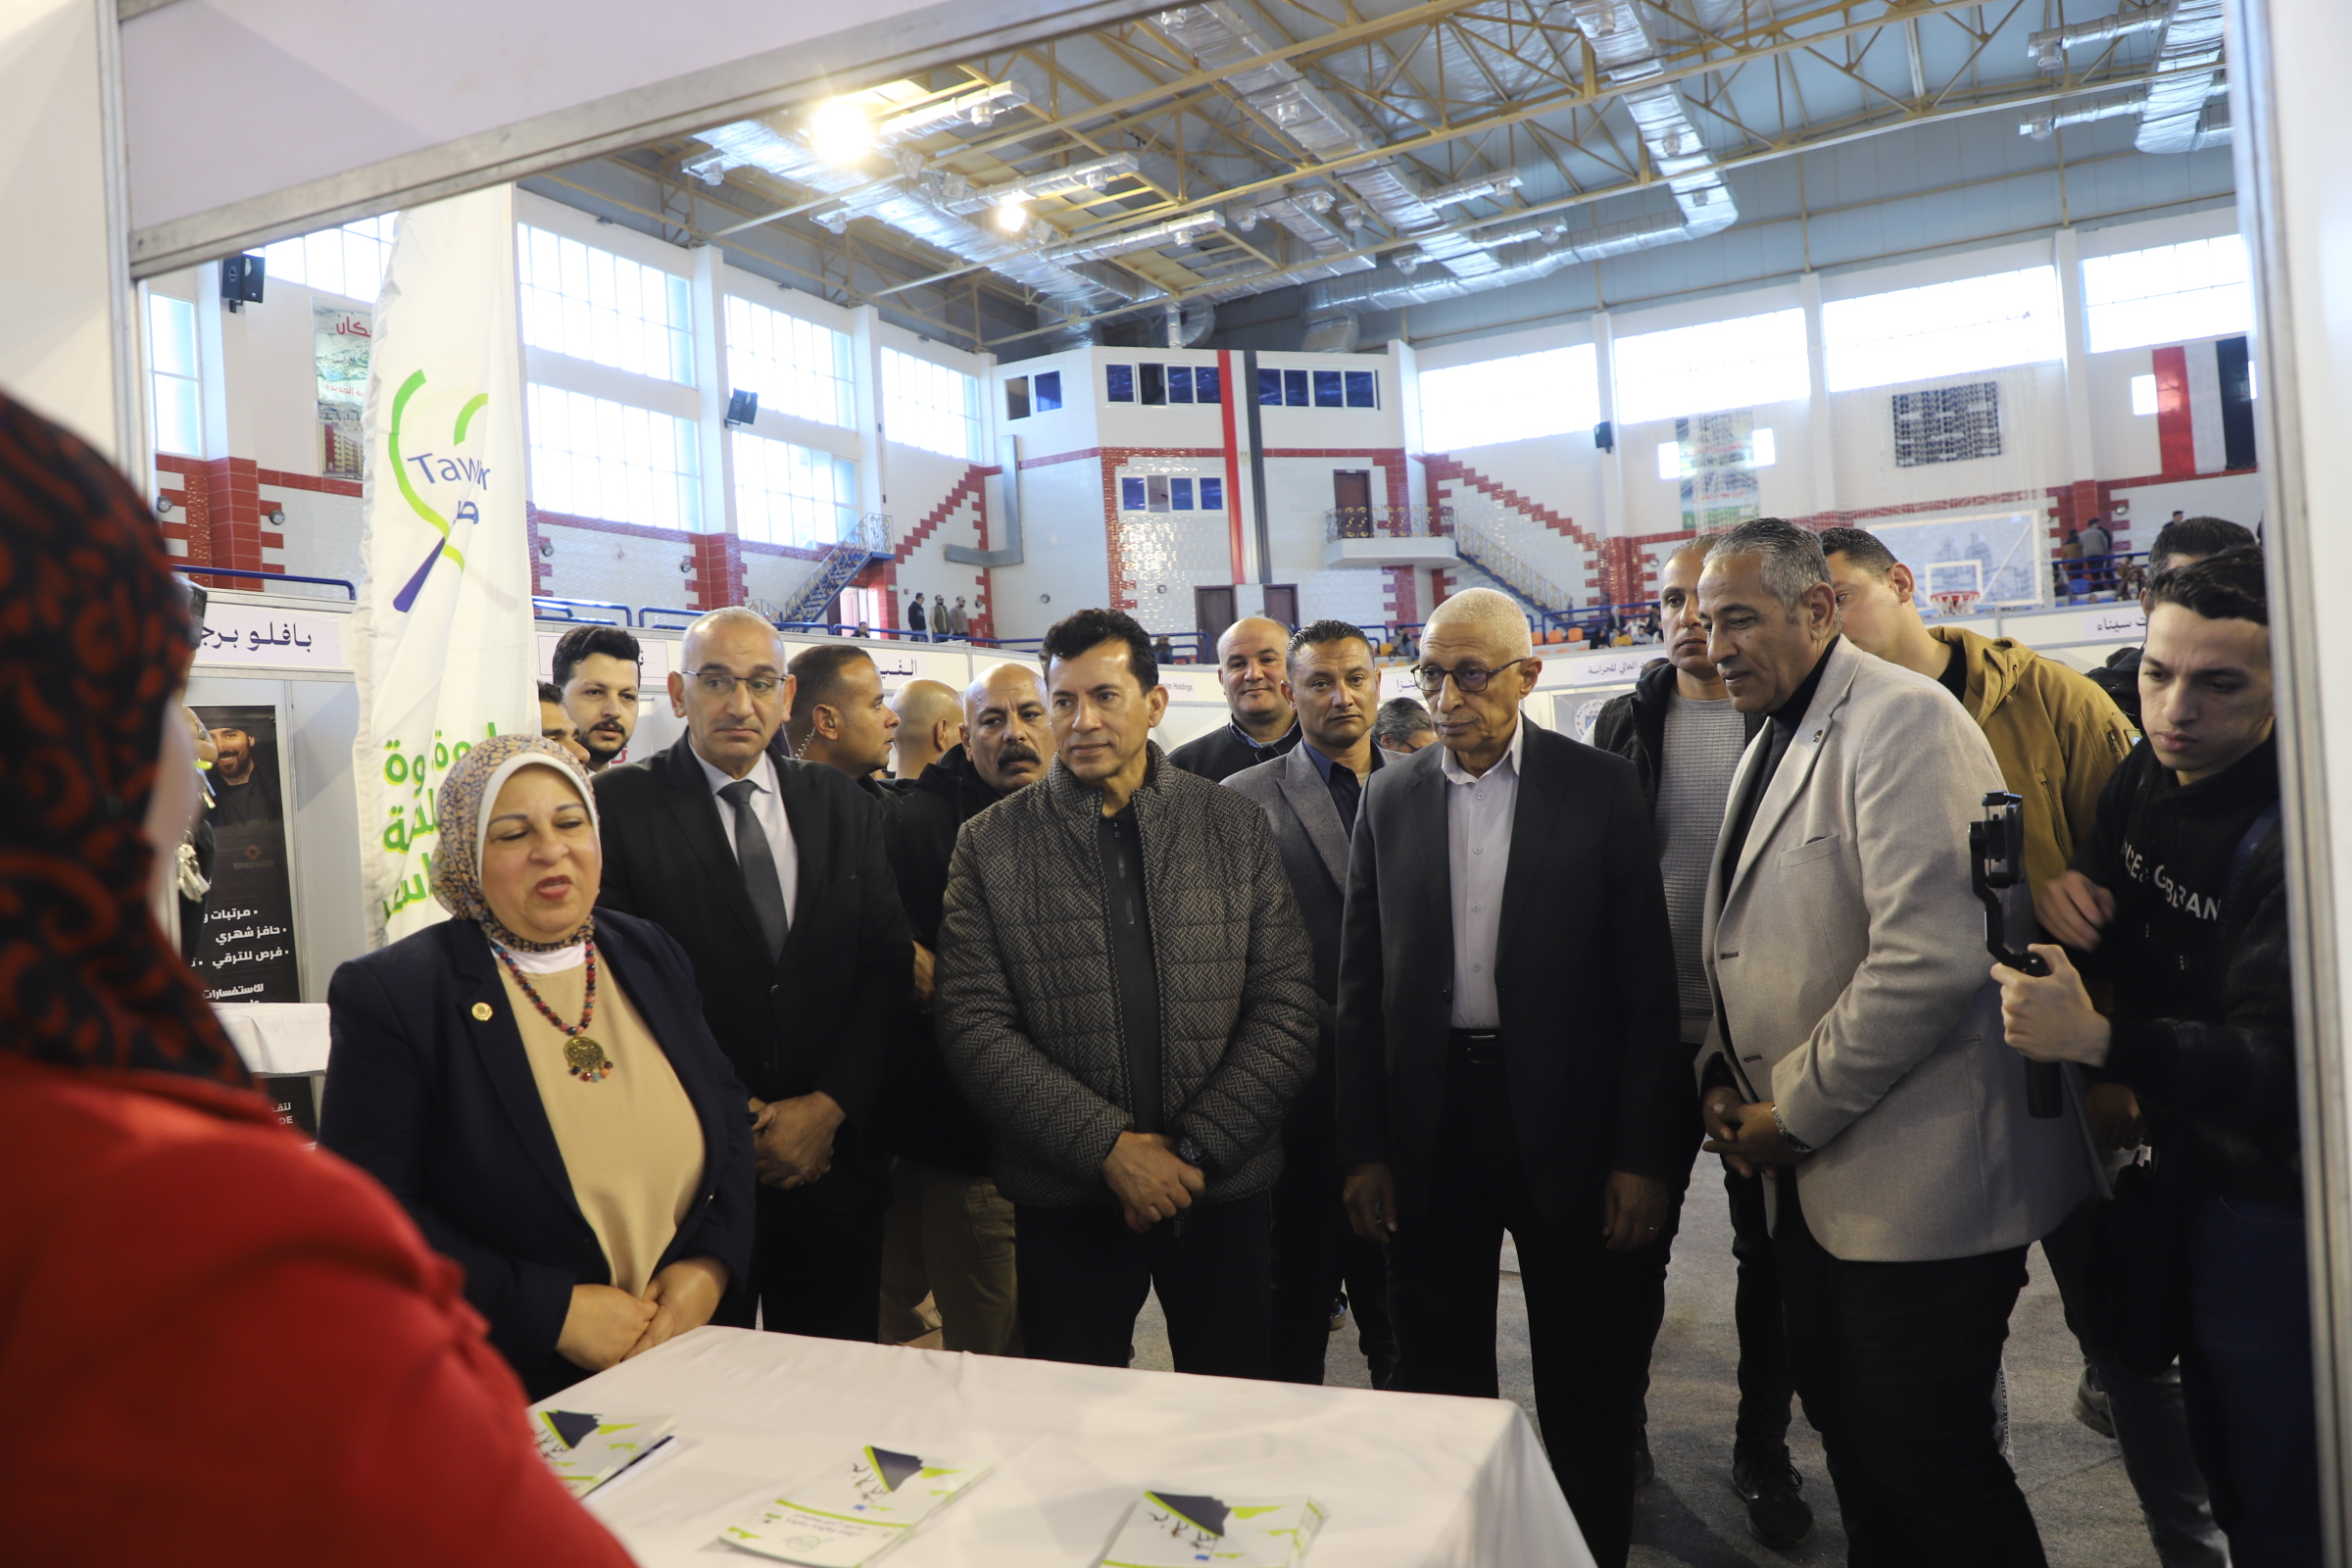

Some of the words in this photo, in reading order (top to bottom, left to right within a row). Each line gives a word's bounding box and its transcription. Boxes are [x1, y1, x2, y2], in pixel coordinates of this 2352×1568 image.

[335, 314, 372, 338] كان
[2097, 616, 2132, 632] سيناء
[200, 625, 239, 650] برج
[246, 620, 313, 653] بافلو
[879, 658, 917, 679] الفي
[1588, 663, 1617, 676] للحراسة
[1618, 661, 1638, 675] العالي
[211, 907, 251, 921] مرتبات
[215, 926, 254, 946] شهري
[256, 925, 280, 939] حافز
[212, 951, 253, 969] للترقي
[255, 947, 283, 961] فرص
[202, 983, 265, 1000] للاستفسارات
